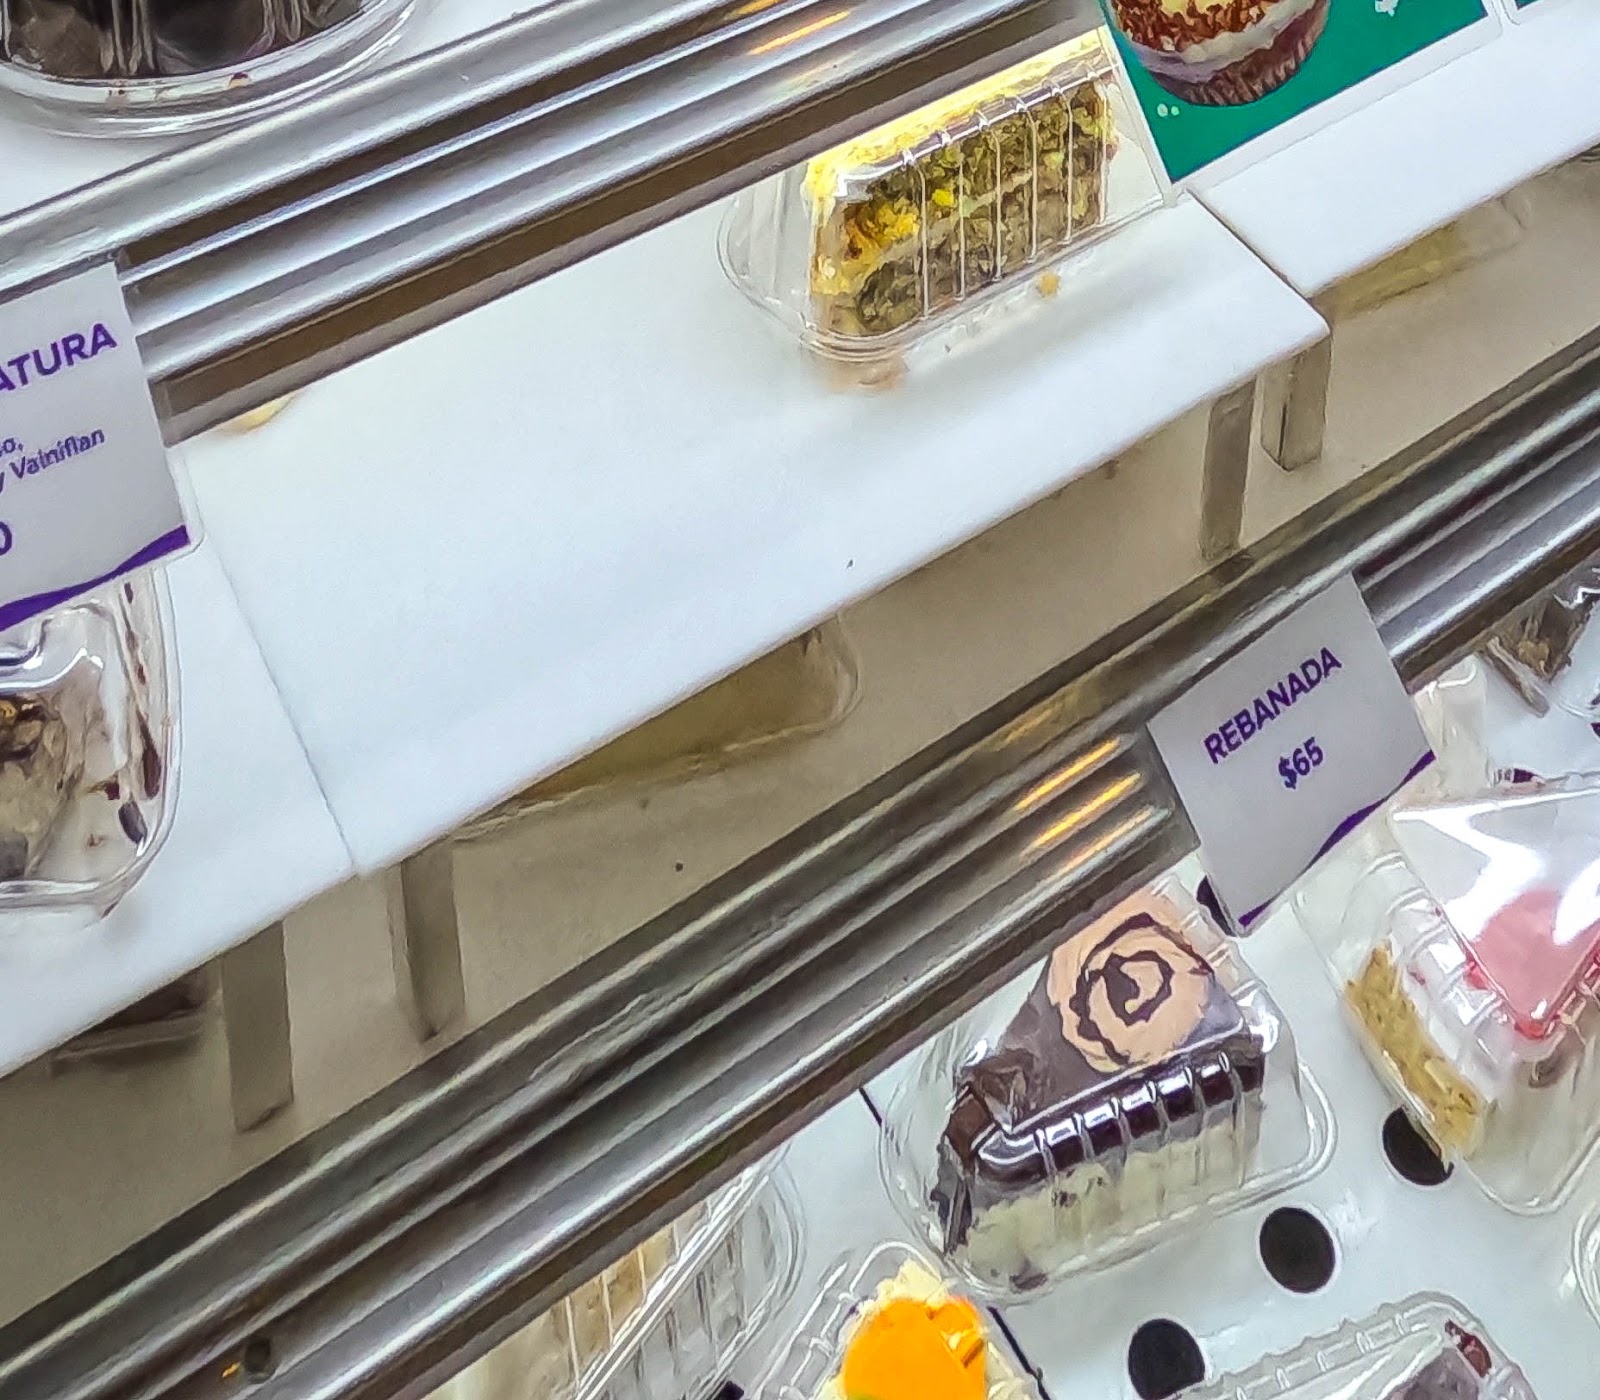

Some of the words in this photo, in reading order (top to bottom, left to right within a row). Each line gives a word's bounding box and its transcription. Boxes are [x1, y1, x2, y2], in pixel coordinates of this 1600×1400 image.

[8, 428, 105, 480] Vainiflan
[1203, 647, 1343, 765] REBANADA
[1277, 736, 1324, 790] $65
